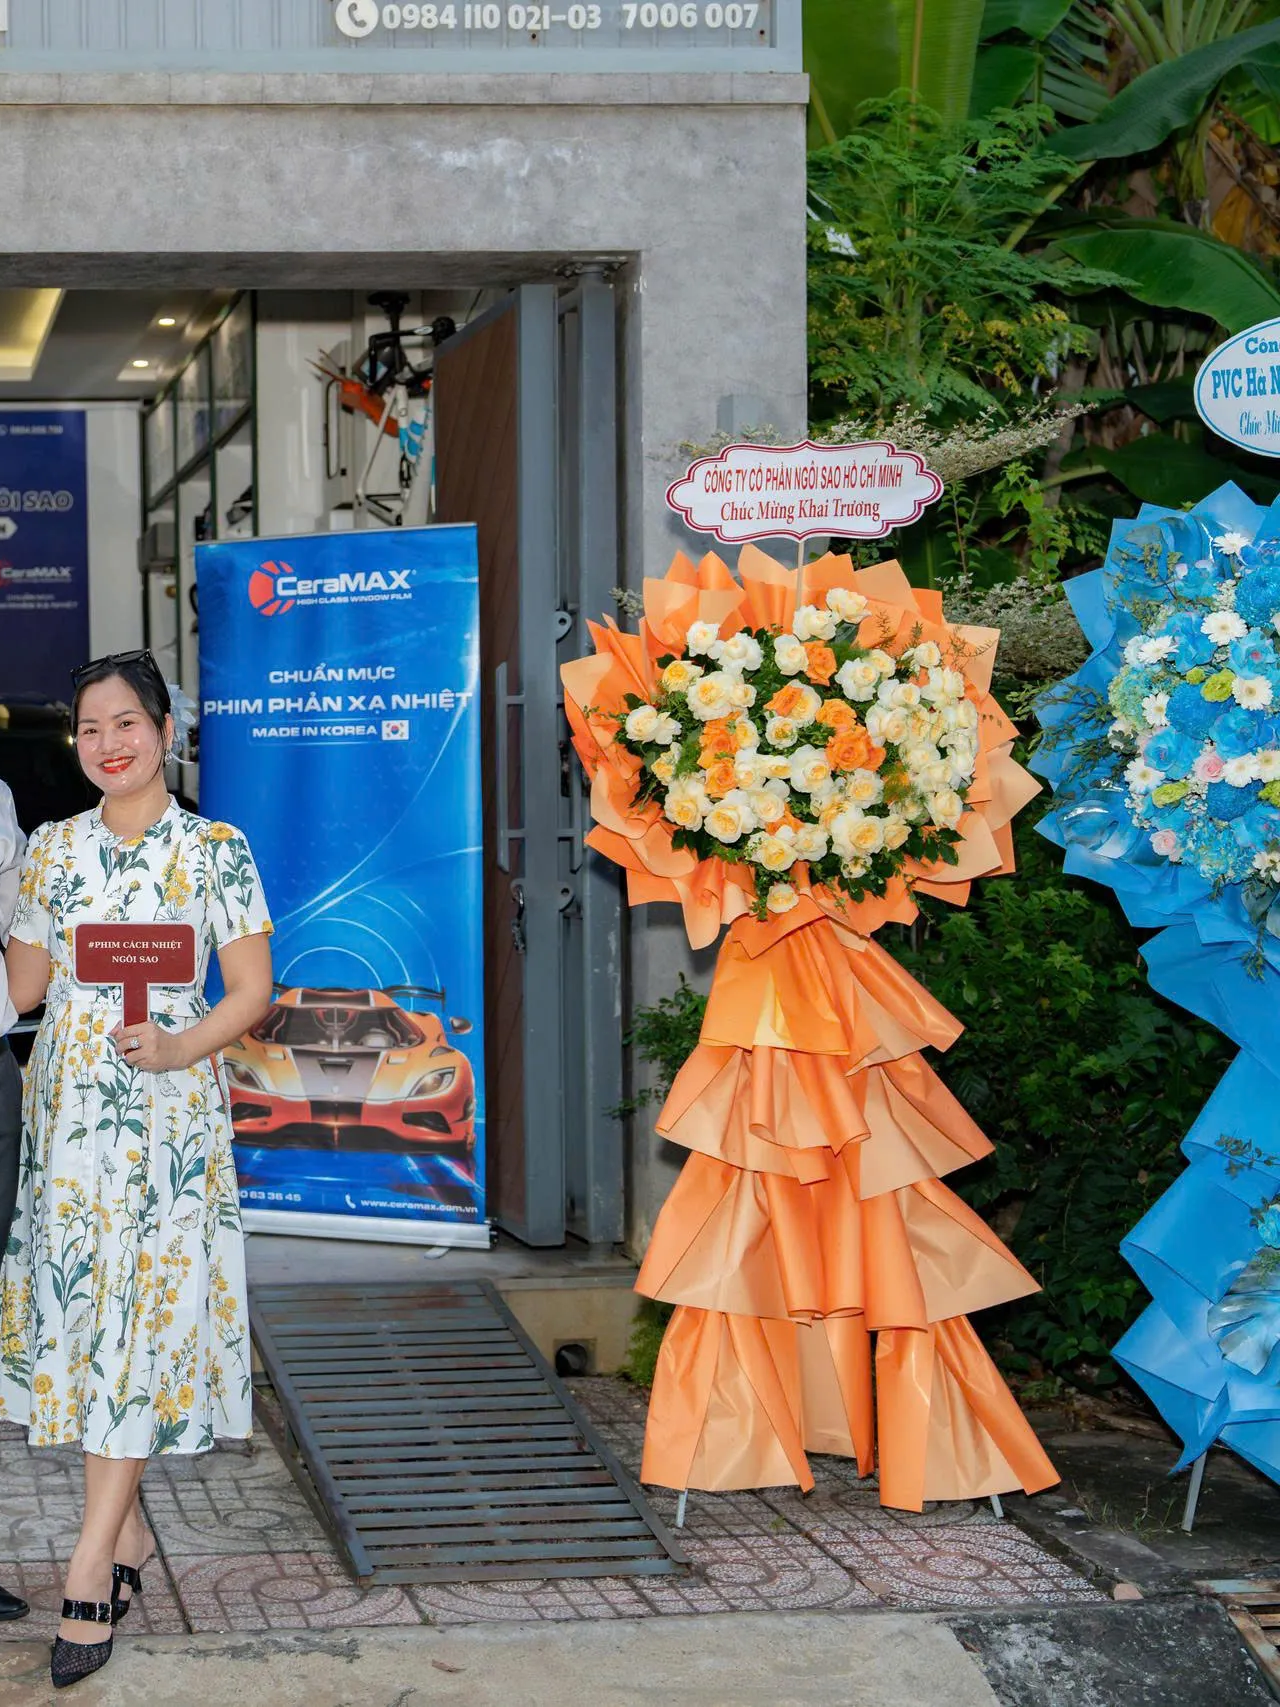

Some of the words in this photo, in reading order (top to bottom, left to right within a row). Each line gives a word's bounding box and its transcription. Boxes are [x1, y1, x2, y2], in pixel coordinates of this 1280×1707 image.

[382, 4, 457, 29] 0984
[464, 4, 500, 29] 110
[508, 4, 602, 30] 021-03
[622, 3, 698, 29] 7006
[704, 3, 759, 28] 007
[1245, 337, 1280, 355] Côn
[1211, 367, 1243, 399] PVC
[1246, 367, 1267, 396] Hà
[704, 464, 733, 493] CÔNG
[736, 468, 748, 492] TY
[794, 460, 819, 490] NGÔI
[821, 465, 841, 490] SAO
[860, 458, 878, 488] CHÍ
[878, 464, 903, 488] MINH
[24, 491, 73, 511] SAO
[721, 500, 754, 521] Chúc
[757, 500, 795, 524] Mừng
[798, 499, 829, 519] Khai
[833, 498, 880, 522] Trương
[297, 597, 317, 605] HIGH
[318, 596, 348, 604] CLASS
[349, 594, 389, 602] WINDOW
[269, 662, 343, 684] CHUẨN
[348, 666, 396, 684] MỰC
[204, 698, 263, 716] PHIM
[269, 691, 342, 713] PHẢN
[347, 695, 385, 715] XẠ
[391, 688, 472, 712] NHIỆT
[252, 727, 300, 738] MADE
[302, 727, 318, 738] IN
[321, 725, 377, 737] KOREA
[88, 941, 120, 949] #PHIM
[123, 940, 149, 949] CÁCH
[152, 940, 182, 952] NHIỆT
[112, 954, 137, 963] NGÔI
[139, 955, 159, 963] SAO
[360, 1199, 478, 1213] www.ceramax.com.vn
